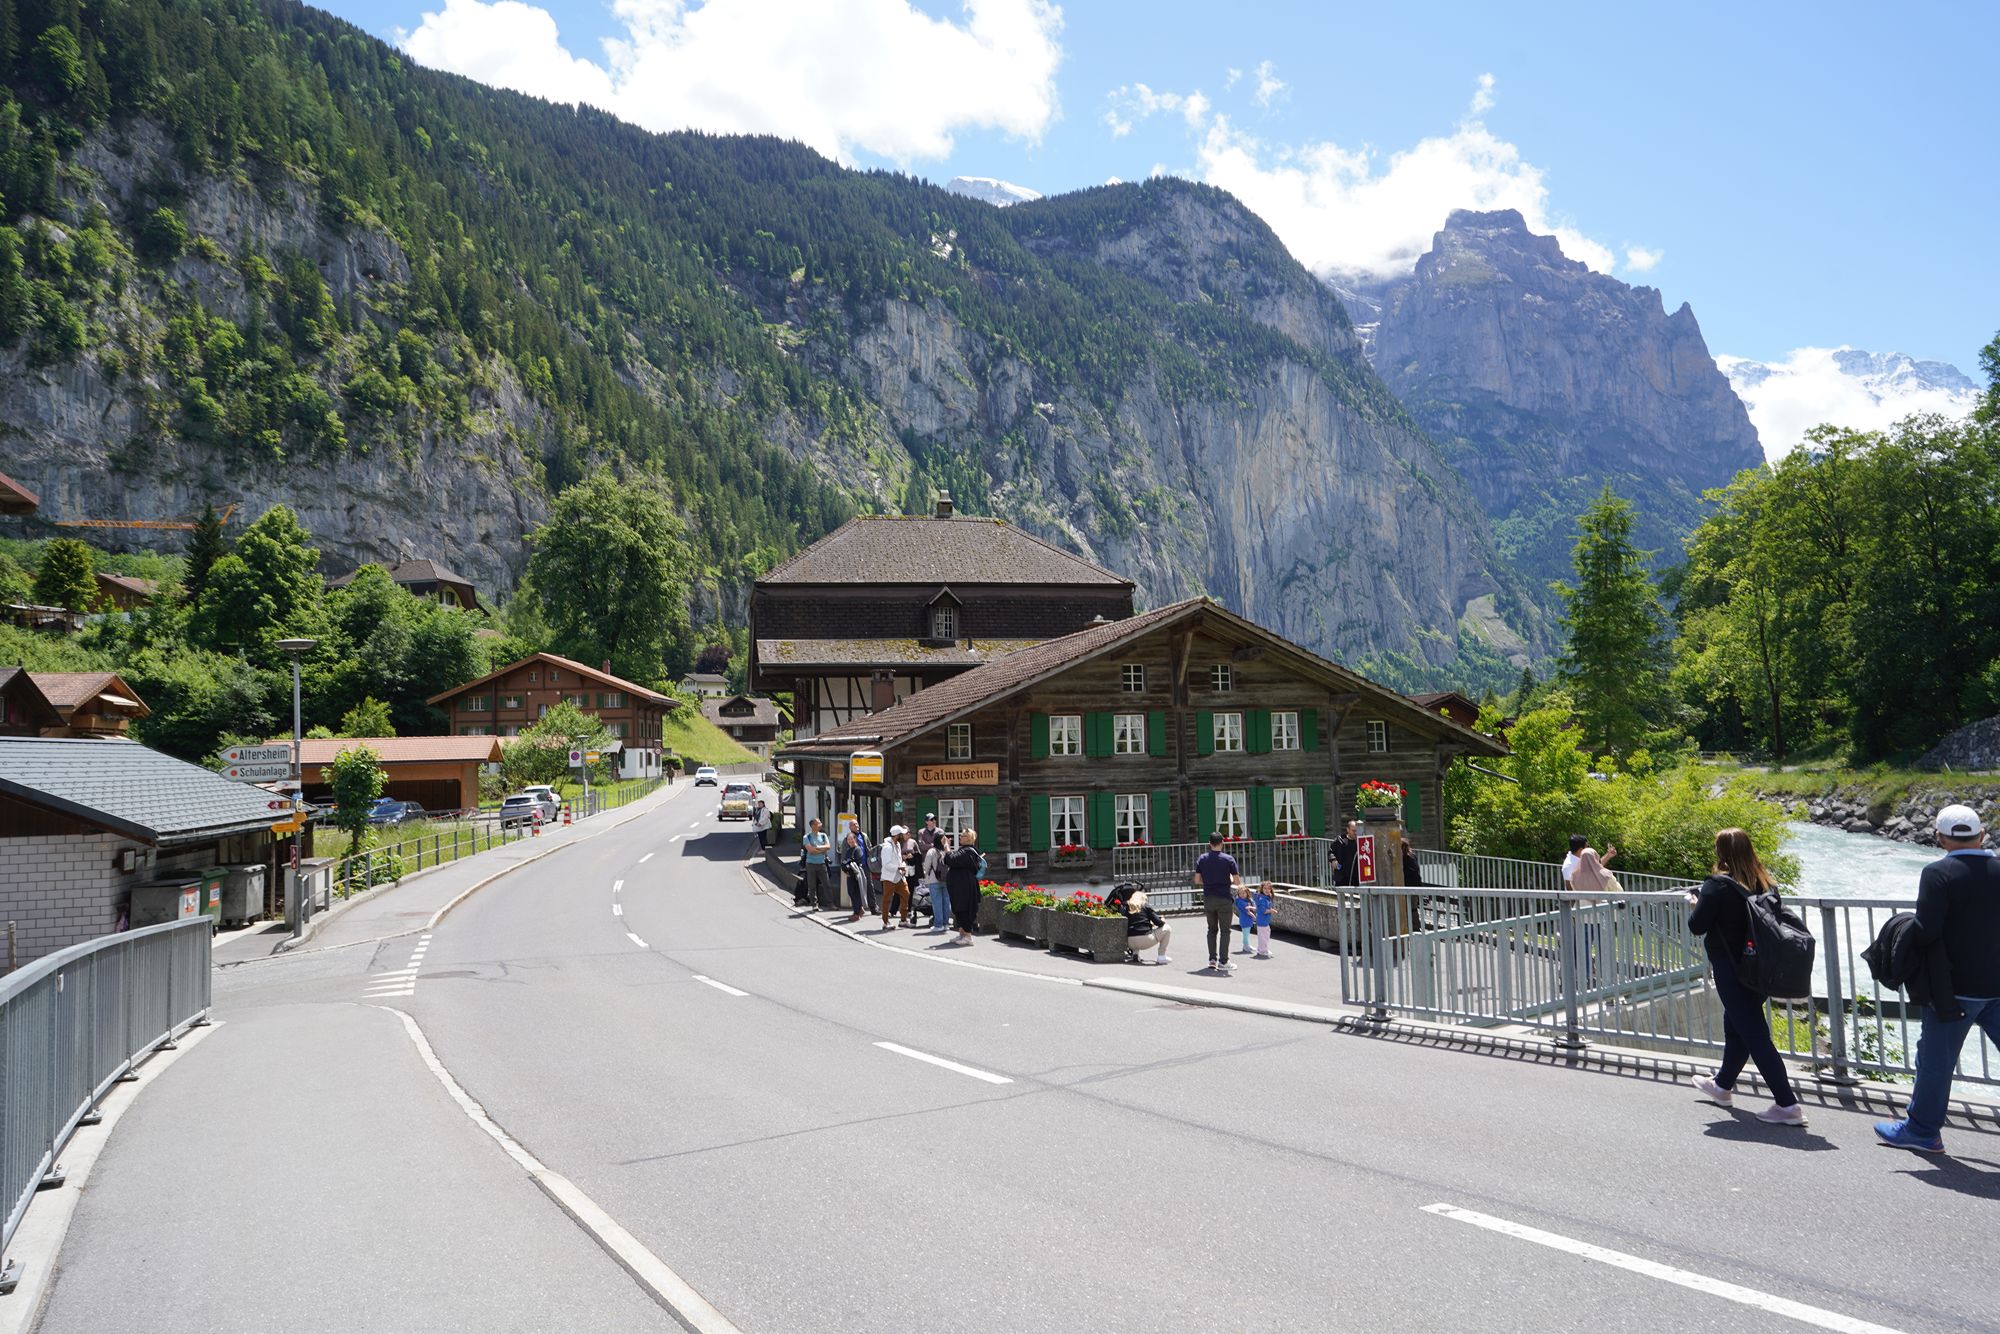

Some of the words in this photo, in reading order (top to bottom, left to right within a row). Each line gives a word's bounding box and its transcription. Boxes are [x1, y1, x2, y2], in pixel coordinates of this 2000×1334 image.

[239, 748, 288, 761] Altersheim
[240, 765, 287, 778] Schulanlage
[922, 768, 994, 782] Talmuseum
